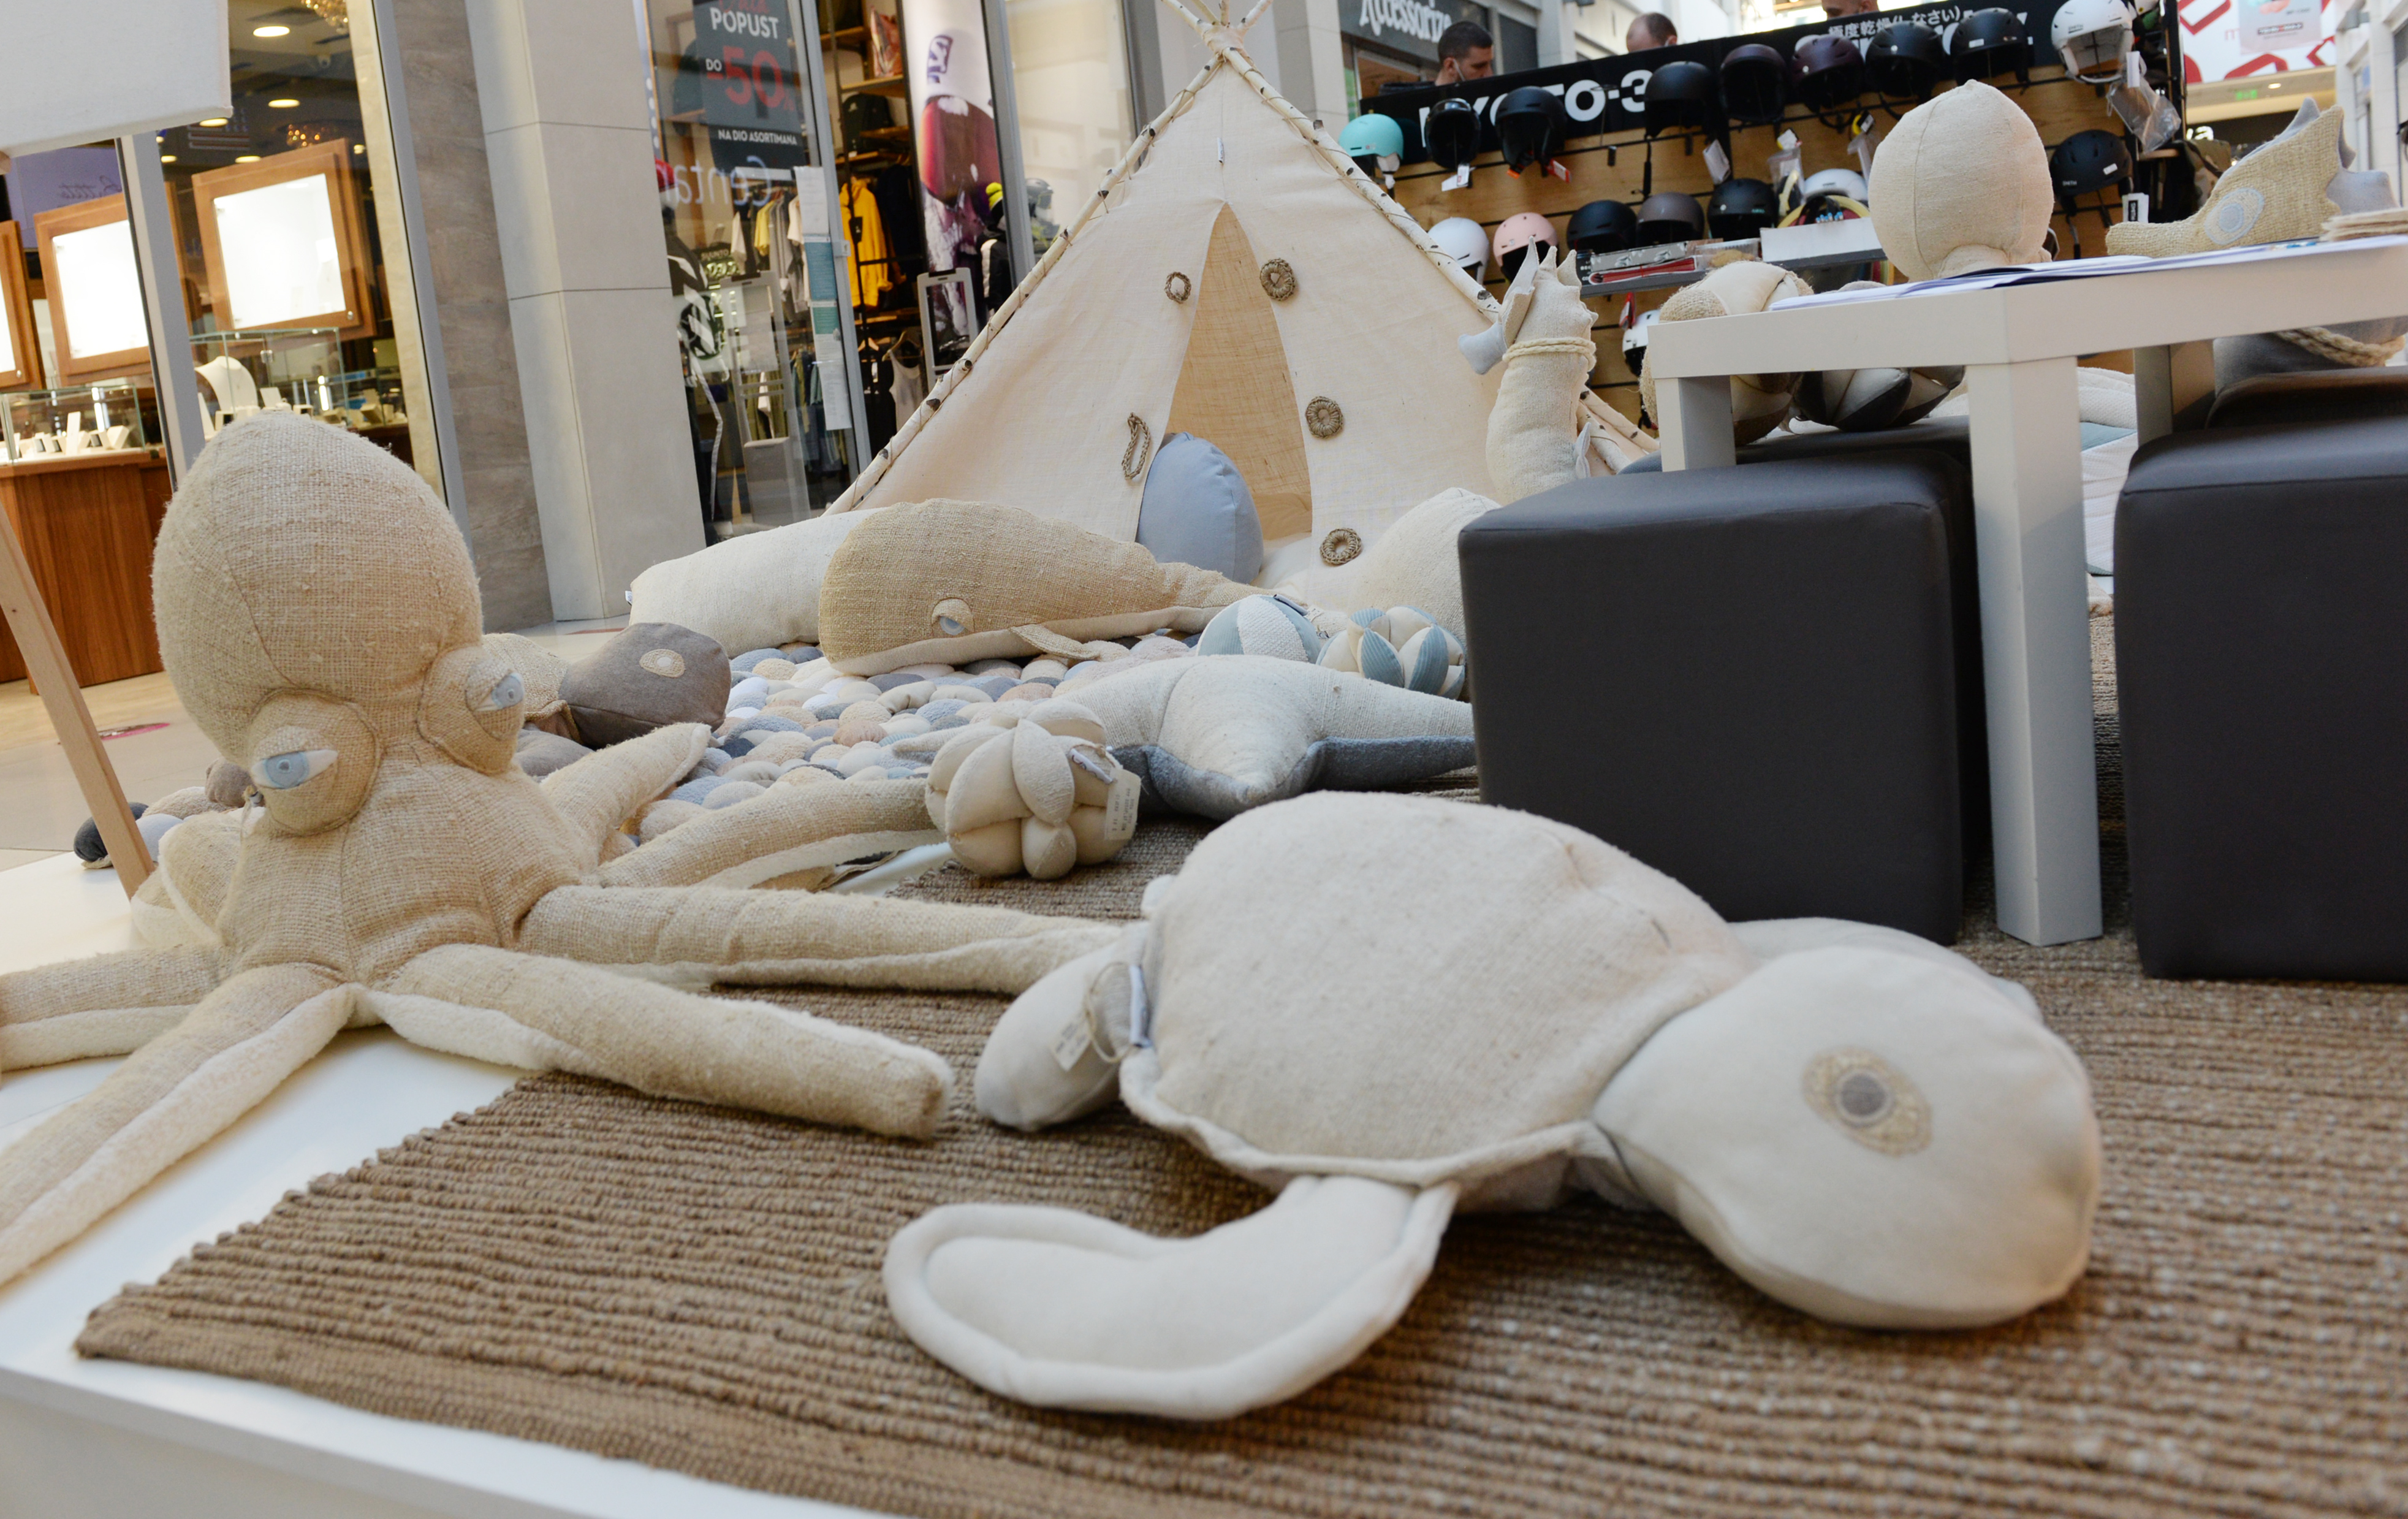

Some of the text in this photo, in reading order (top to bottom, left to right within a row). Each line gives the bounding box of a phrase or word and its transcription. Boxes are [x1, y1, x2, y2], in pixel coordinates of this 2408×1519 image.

[710, 7, 779, 39] POPUST
[705, 58, 722, 72] DO
[718, 129, 797, 146] NA DIO ASORTIMANA
